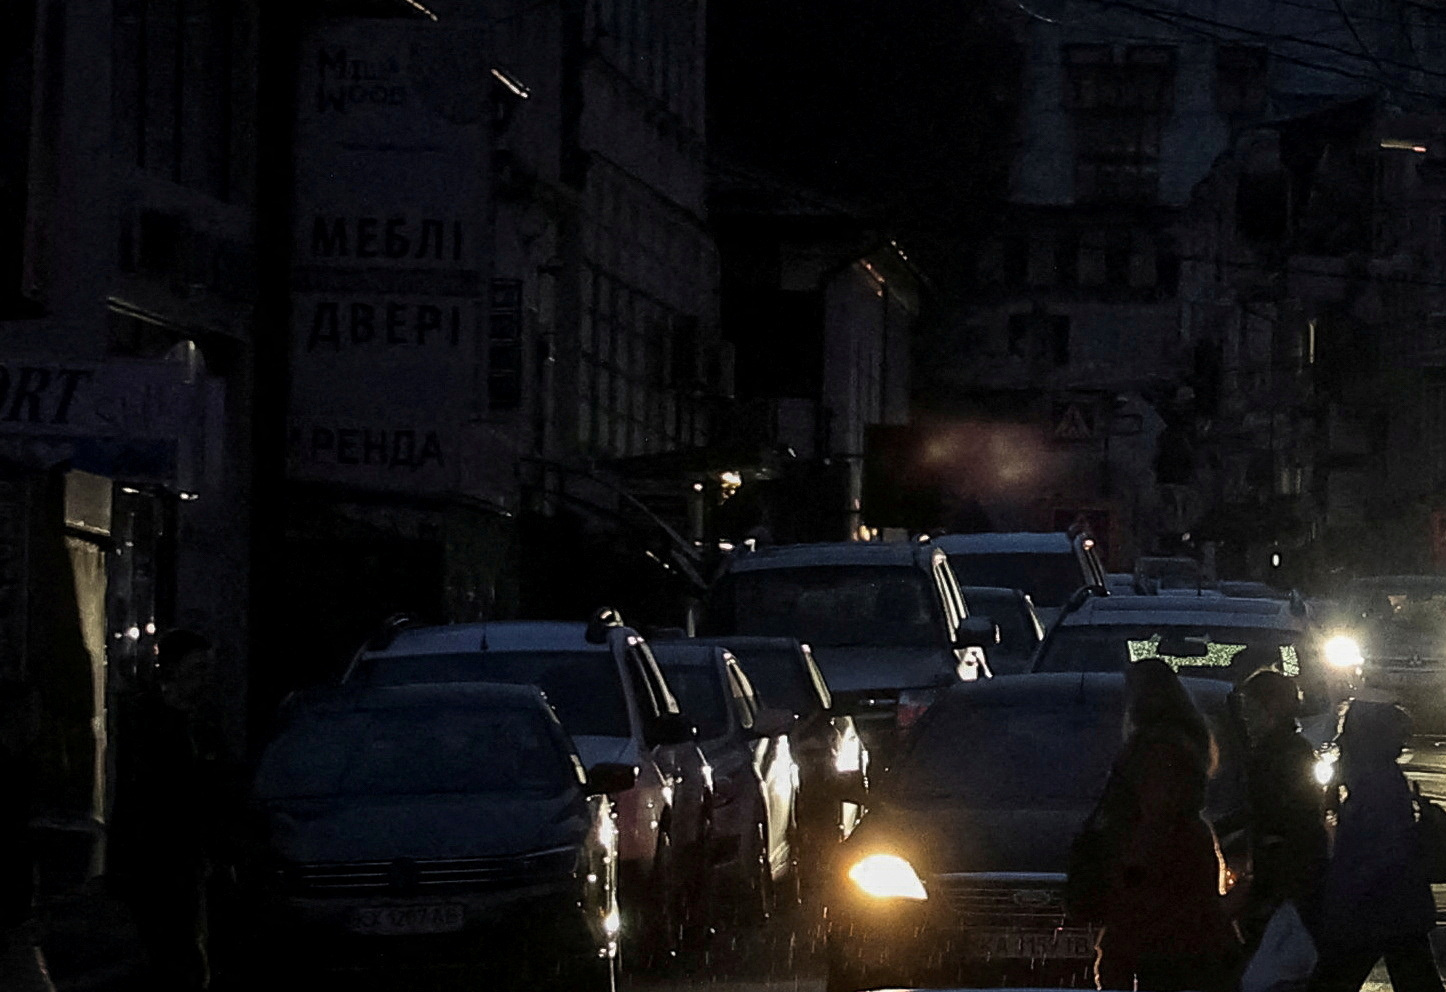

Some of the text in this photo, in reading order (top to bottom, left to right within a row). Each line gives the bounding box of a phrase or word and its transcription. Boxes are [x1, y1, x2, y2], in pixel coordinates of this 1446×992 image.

[311, 216, 462, 261] МЕБЛІ
[307, 302, 460, 352] ДВЕРІ
[291, 426, 445, 472] РЕНДА
